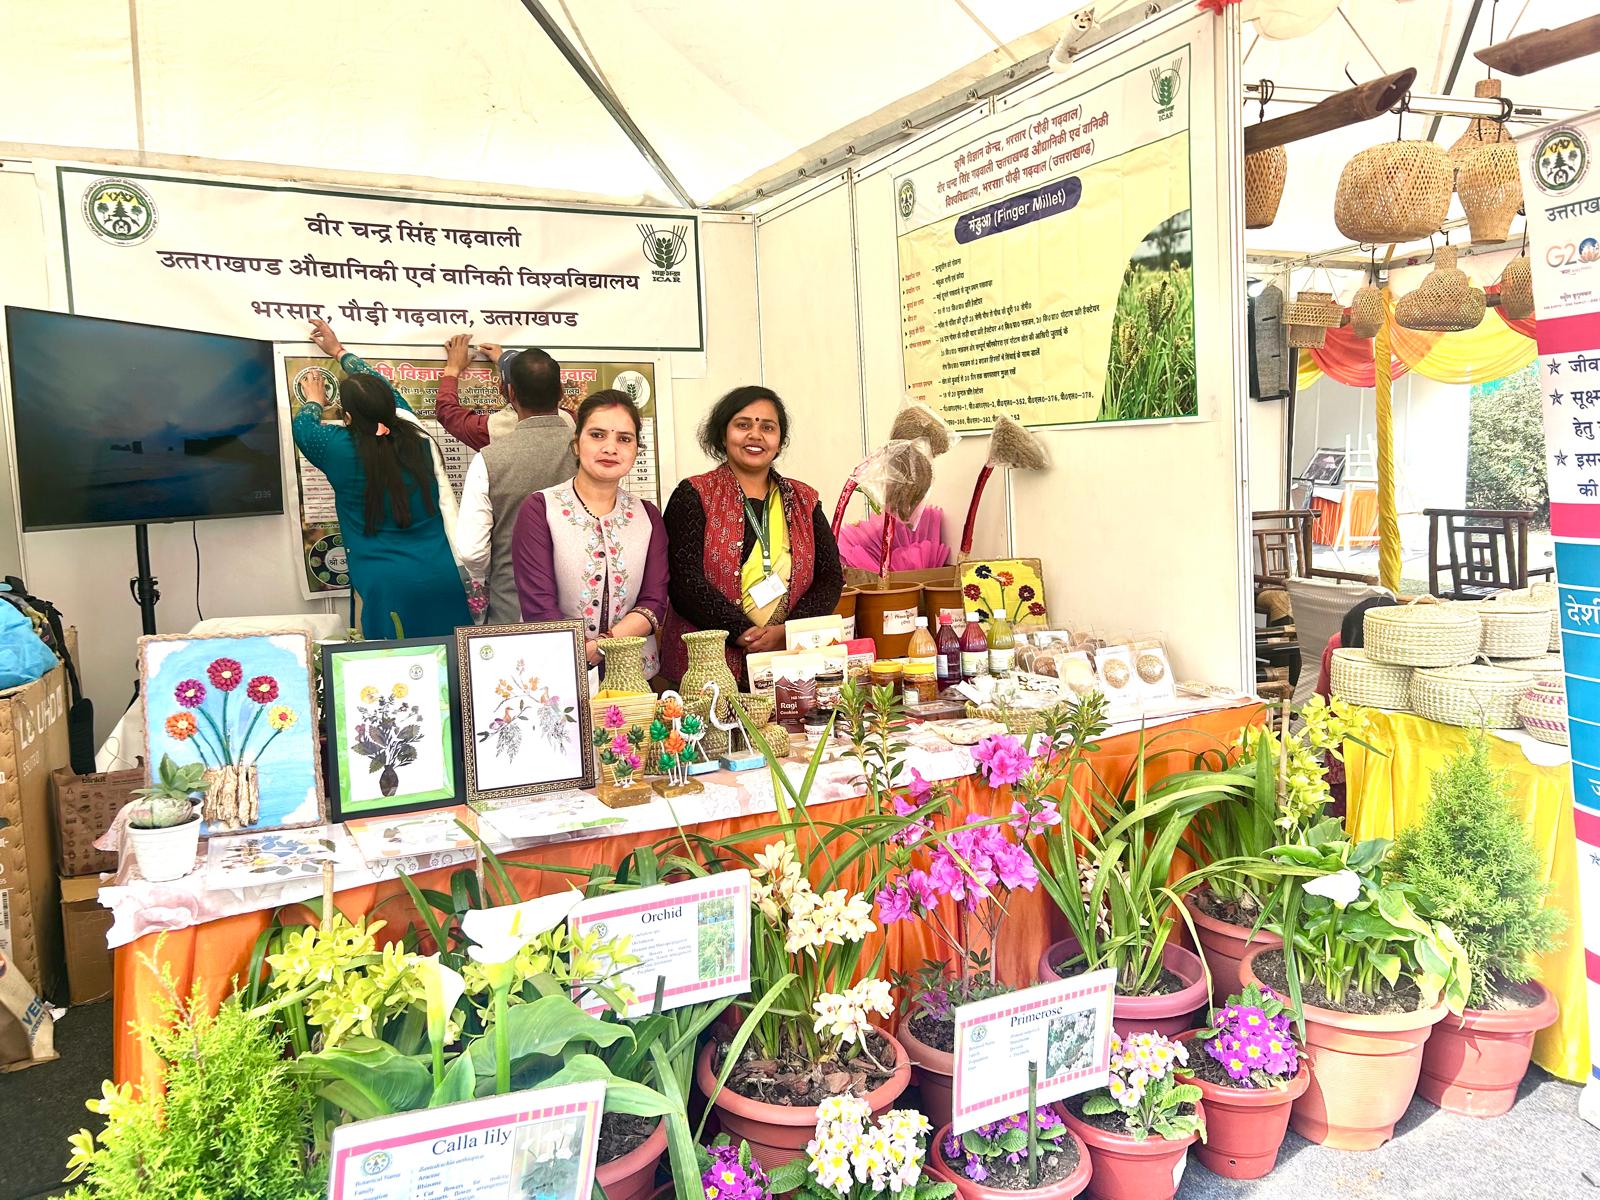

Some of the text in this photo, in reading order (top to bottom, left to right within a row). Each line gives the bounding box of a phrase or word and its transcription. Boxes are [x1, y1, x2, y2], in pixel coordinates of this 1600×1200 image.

[953, 154, 965, 171] कृषि
[966, 147, 983, 163] विज्ञान
[1005, 128, 1026, 145] भरसार
[958, 170, 970, 184] सिंह
[1068, 124, 1080, 141] एवं
[1082, 111, 1108, 133] वानिकी
[1004, 166, 1020, 183] पौड़ी
[993, 203, 1029, 226] (Finger
[1032, 188, 1065, 211] Millet)
[304, 213, 522, 249] वीर चन्द्र सिंह गढ़वाली
[156, 250, 640, 290] उत्तराखण्ड औद्यानिकी एवं वानिकी विश्वविद्यालय
[251, 299, 579, 328] भरसार, पौड़ी गढ़वाल, उत्तराखण्ड
[1572, 417, 1595, 440] हेतु
[1577, 478, 1599, 497] की
[780, 702, 798, 710] Ragi
[641, 906, 682, 924] Orchid
[1011, 1006, 1063, 1027] Primerose
[432, 1128, 512, 1155] Calla lily
